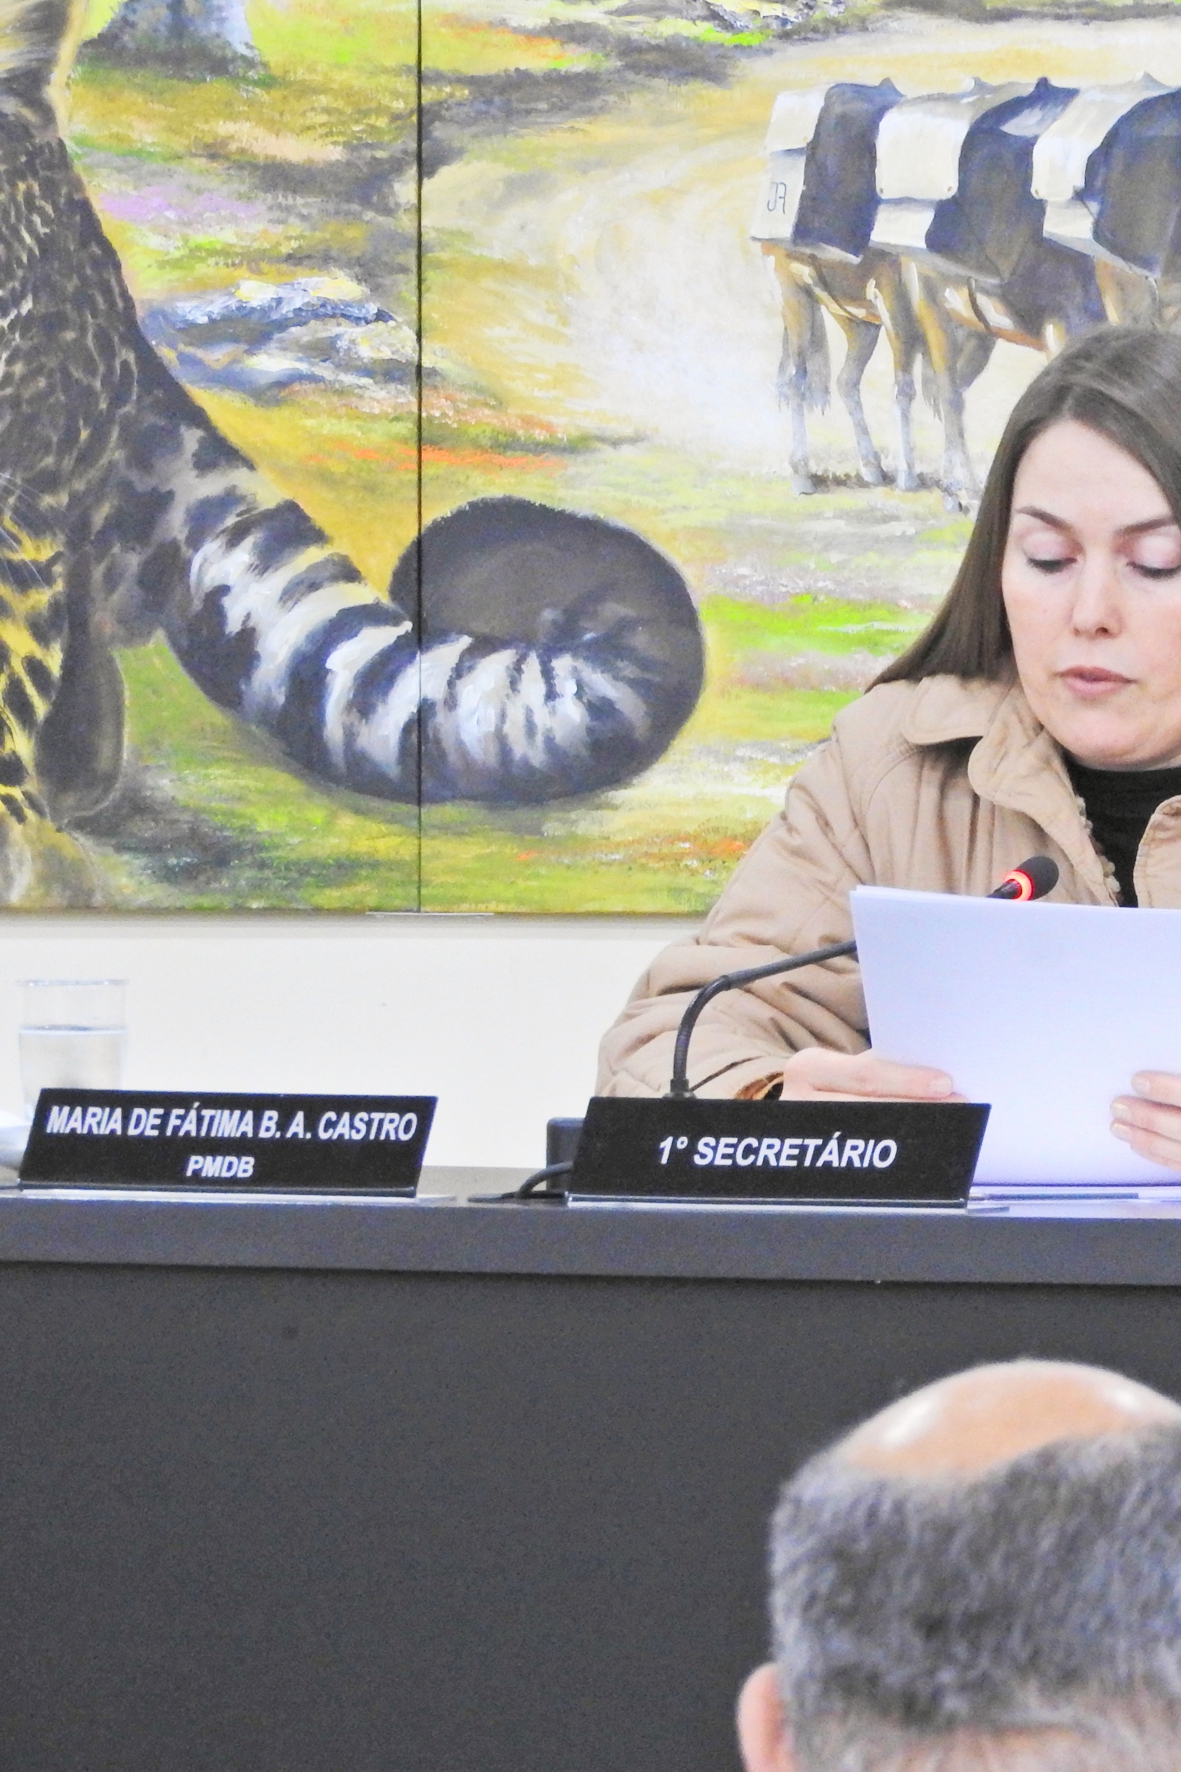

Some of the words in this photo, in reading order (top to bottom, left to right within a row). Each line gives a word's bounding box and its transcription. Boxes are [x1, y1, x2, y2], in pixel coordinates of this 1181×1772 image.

[46, 1105, 123, 1136] MARIA
[127, 1107, 165, 1137] DE
[166, 1102, 254, 1138] FÁTIMA
[258, 1109, 281, 1139] B.
[286, 1111, 312, 1140] A.
[317, 1111, 418, 1142] CASTRO
[186, 1155, 256, 1179] PMDB
[693, 1131, 898, 1169] SECRETÁRIO
